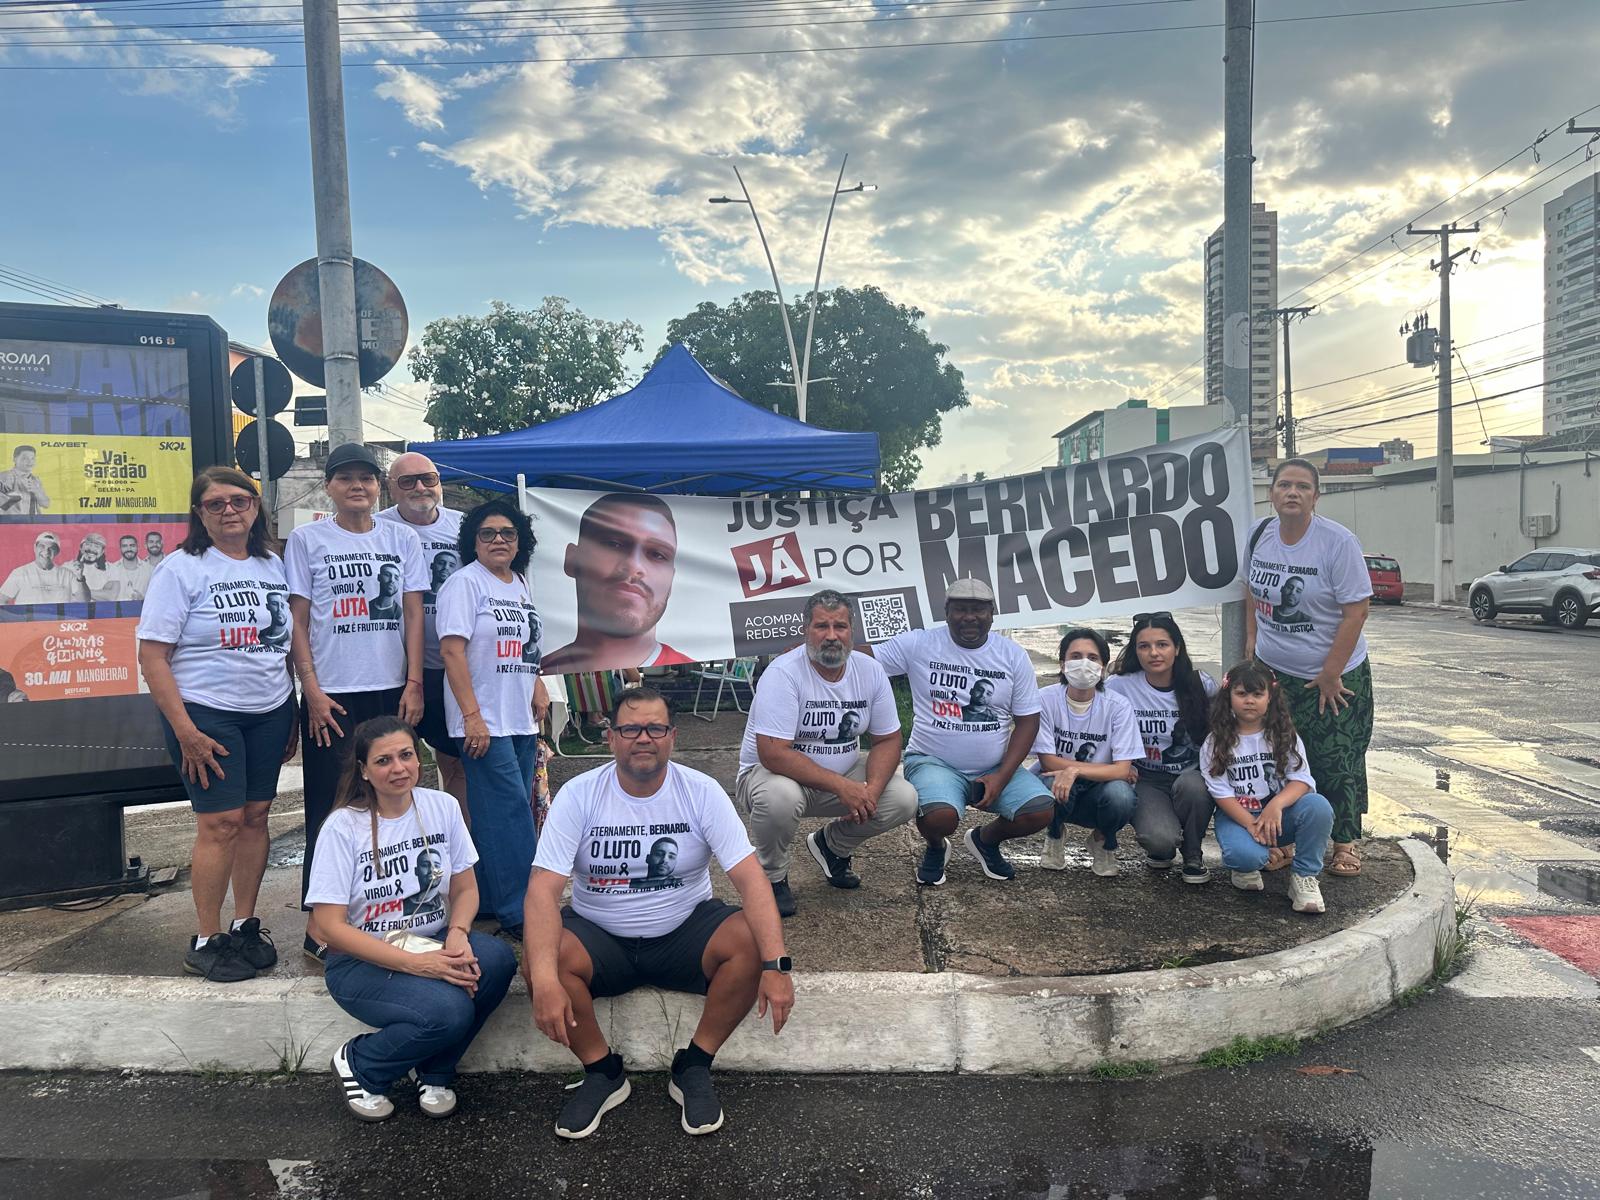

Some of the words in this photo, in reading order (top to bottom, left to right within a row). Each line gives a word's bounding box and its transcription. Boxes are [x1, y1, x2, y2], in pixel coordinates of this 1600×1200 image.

[140, 335, 163, 345] 016
[159, 441, 186, 451] SKOL
[914, 442, 1229, 542] BERNARDO
[79, 497, 112, 508] 17.JAN
[727, 495, 898, 533] JUSTIÇA
[747, 536, 805, 591] JÁ
[814, 542, 903, 578] POR
[920, 506, 1238, 622] MACEDO
[328, 565, 337, 580] O
[339, 563, 372, 579] LUTO
[1255, 570, 1280, 587] LUTO
[331, 583, 354, 595] VIROU
[214, 594, 224, 609] O
[225, 591, 260, 608] LUTO
[333, 597, 368, 618] LUTA
[219, 611, 246, 623] VIROU
[493, 609, 503, 621] O
[502, 609, 525, 623] LUTO
[333, 625, 337, 634] A
[337, 624, 351, 634] PAZ
[351, 622, 356, 633] É
[357, 623, 378, 632] FRUTO
[497, 626, 516, 636] VIROU
[746, 626, 787, 640] REDES
[220, 627, 260, 647] LUTA
[497, 640, 521, 658] LUTA
[496, 665, 500, 673] A
[509, 663, 513, 672] É
[929, 661, 973, 675] ETERNAMENTE,
[24, 670, 72, 686] 30.MAI
[930, 672, 938, 685] O
[940, 673, 967, 689] LUTO
[929, 689, 949, 700] VIROU
[932, 701, 961, 718] LUTA
[802, 711, 811, 727] O
[811, 711, 835, 726] LUTO
[936, 720, 947, 729] PAZ
[947, 721, 951, 729] É
[951, 722, 971, 732] FRUTO
[972, 723, 980, 732] DA
[1139, 720, 1166, 733] LUTO
[798, 730, 819, 739] VIROU
[807, 743, 812, 753] É
[812, 746, 832, 755] FRUTO
[833, 747, 840, 755] DA
[590, 826, 648, 837] ETERNAMENTE,
[649, 822, 692, 835] BERNARDO.
[591, 841, 600, 858] O
[603, 840, 641, 859] LUTO
[363, 865, 372, 882] O
[376, 855, 409, 880] LUTO
[589, 864, 616, 875] VIROU
[364, 884, 392, 900] VIROU
[364, 921, 379, 932] PAZ
[381, 919, 386, 931] É
[388, 917, 413, 931] FRUTO
[415, 916, 425, 926] DA
